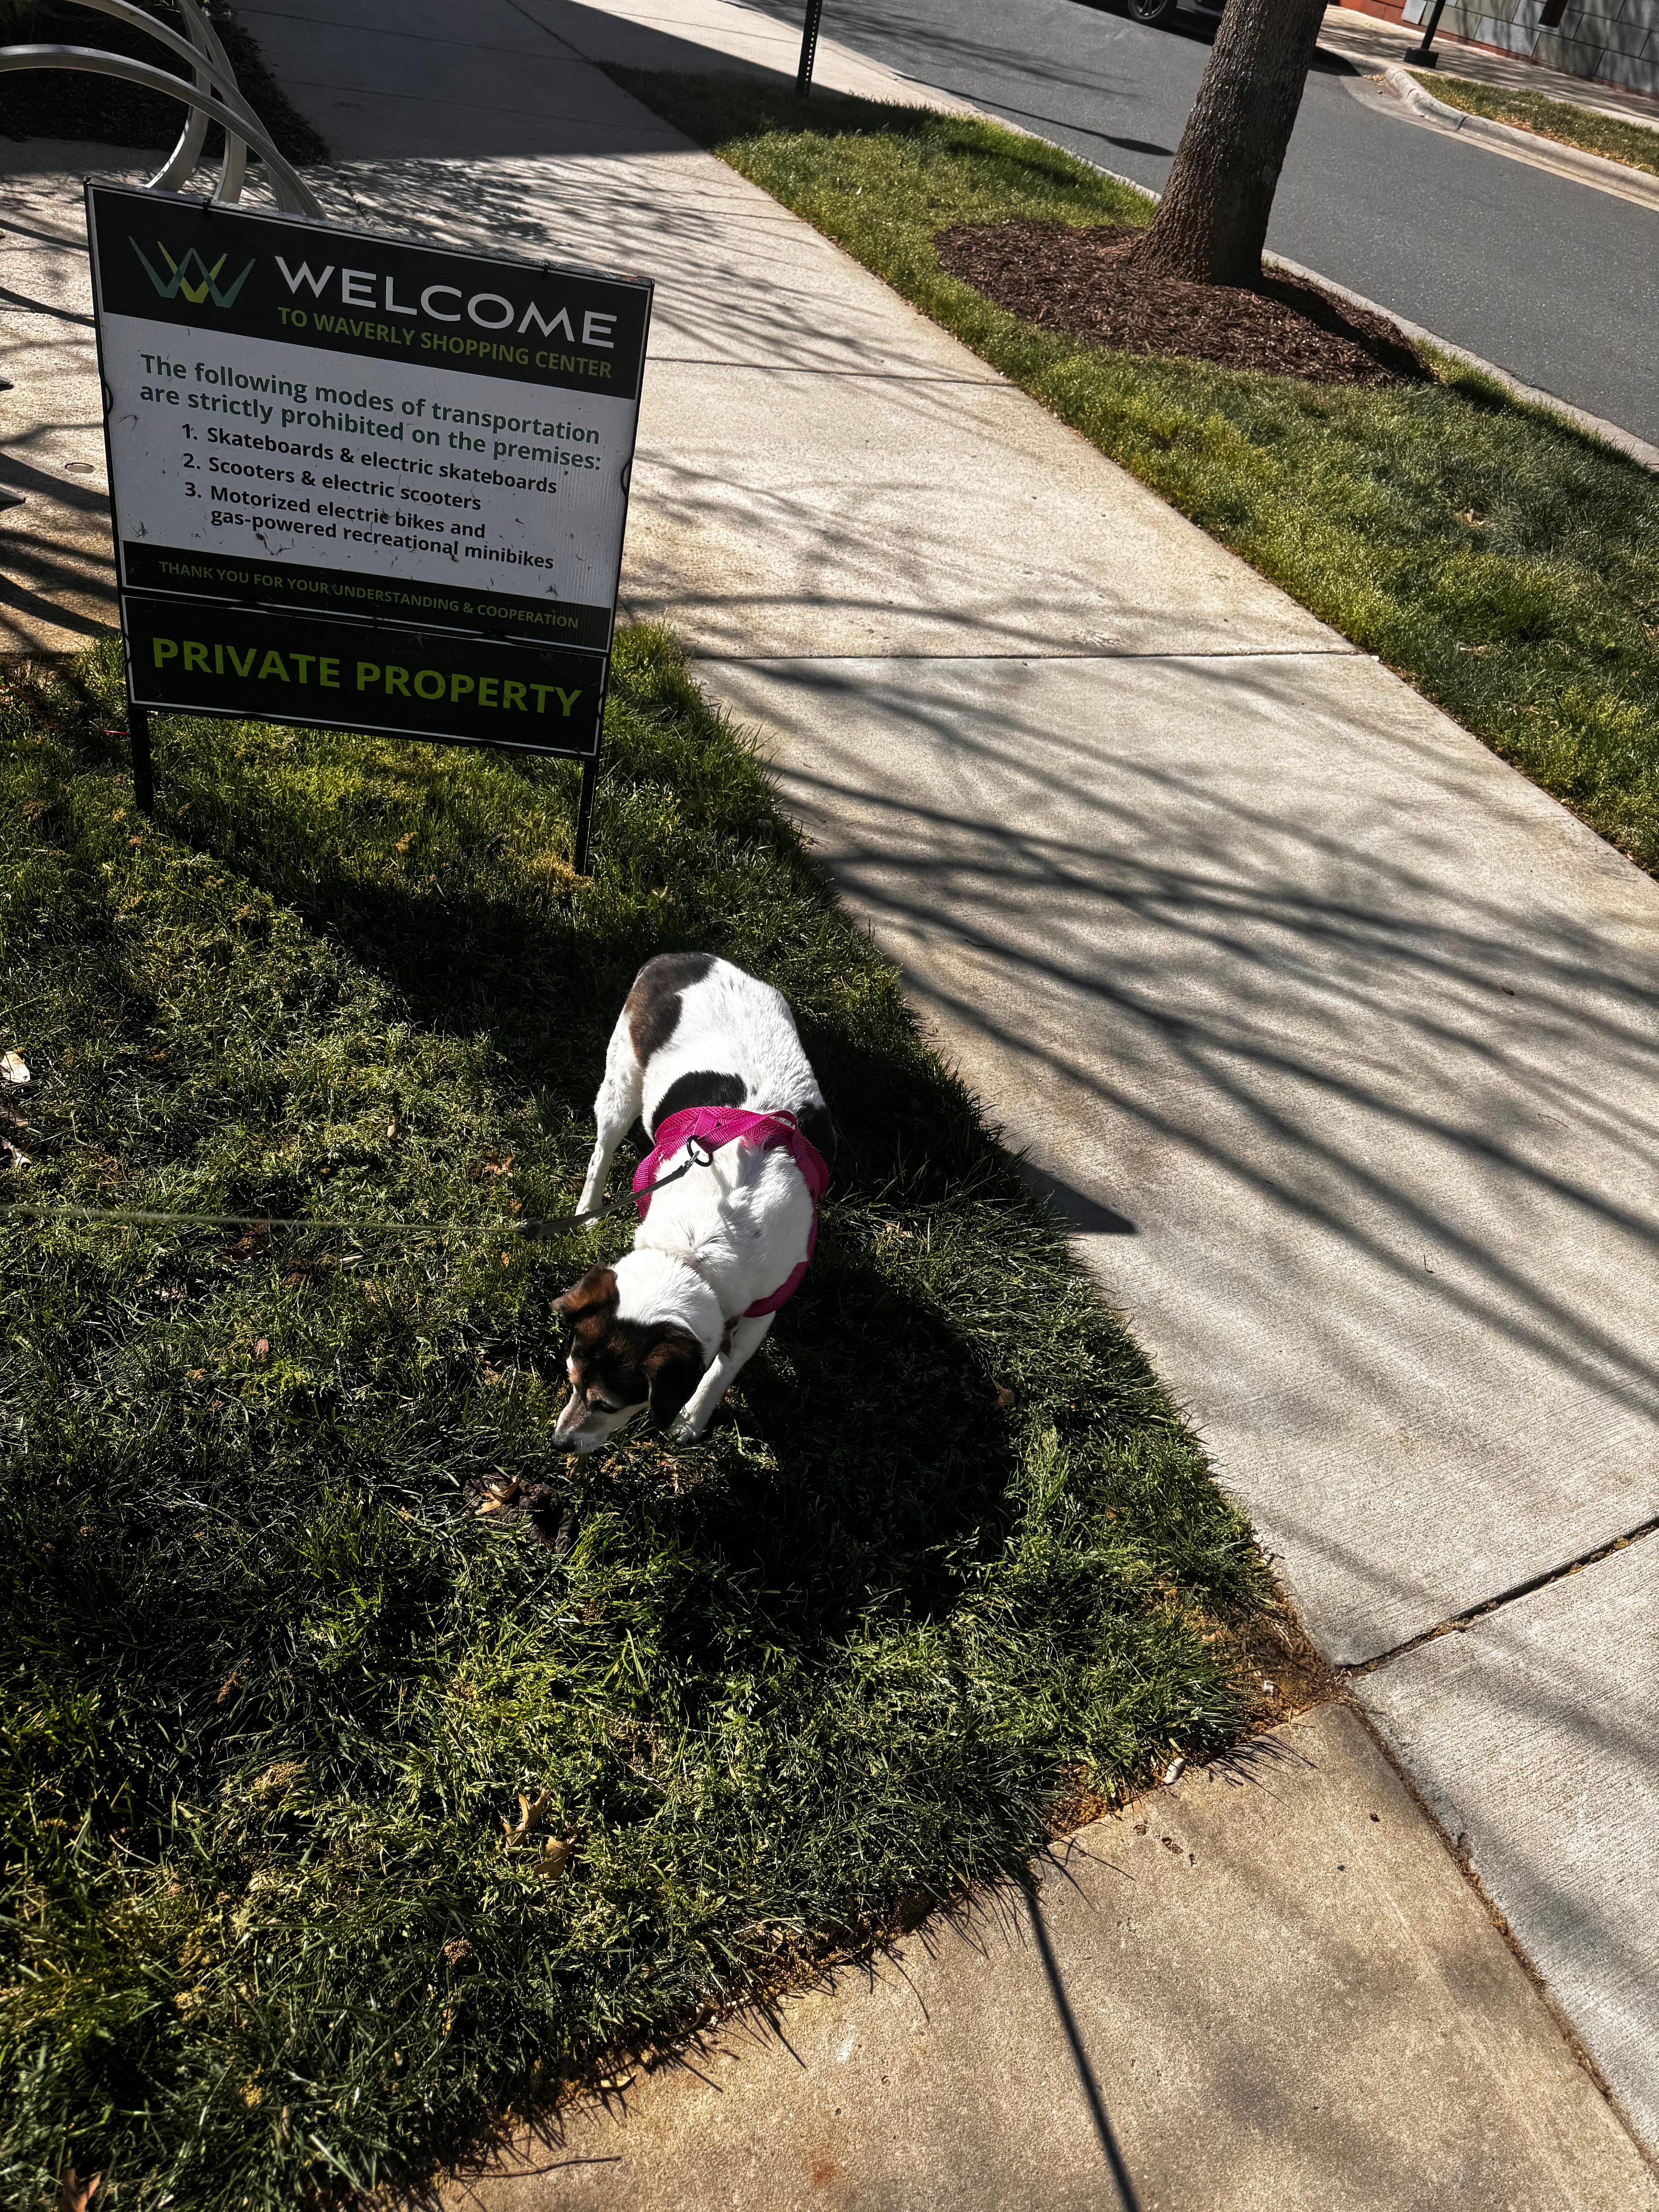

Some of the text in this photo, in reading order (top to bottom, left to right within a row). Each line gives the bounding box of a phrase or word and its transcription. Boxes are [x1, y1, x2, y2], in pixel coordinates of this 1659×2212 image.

[275, 256, 617, 348] WELCOME
[278, 307, 612, 378] TO WAVERLY SHOPPING CENTER
[140, 386, 601, 470] are strictly prohibited on the premises:
[141, 354, 599, 444] The following modes of transportation
[182, 424, 557, 494] 1. Skateboards & electric skateboards
[183, 453, 481, 510] 2. Scooters & electric scooters
[185, 482, 485, 539] 3. Motorized electric bikes and
[211, 510, 554, 569] gas-powered recreational minibikes
[159, 562, 578, 628] THANK YOU FOR YOUR UNDERSTANDING & COOPERATION
[153, 638, 582, 716] PRIVATE PROPERTY
